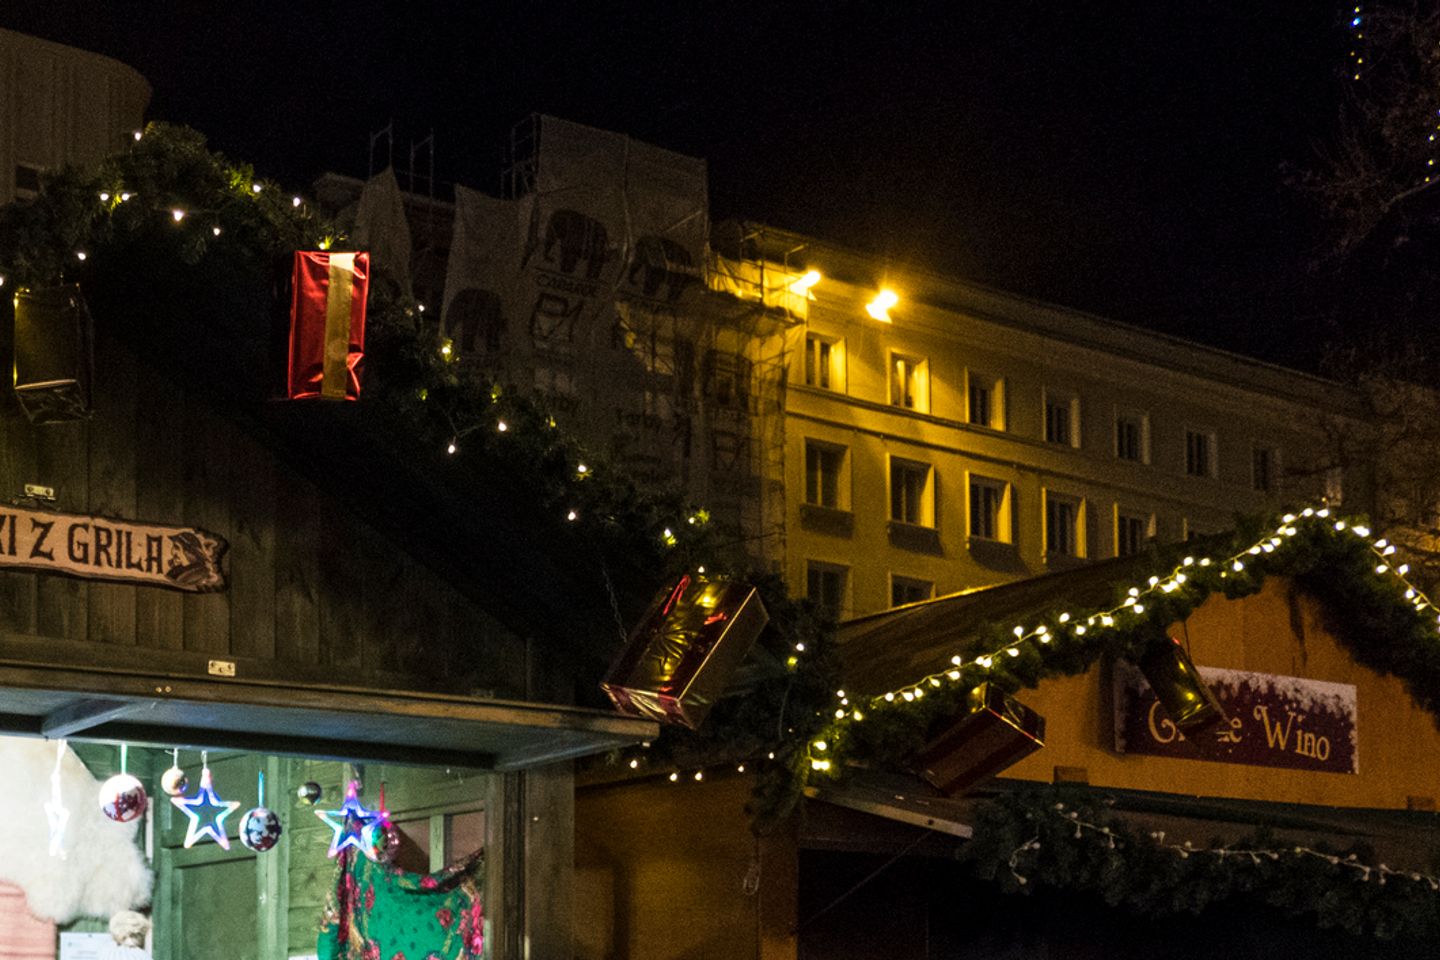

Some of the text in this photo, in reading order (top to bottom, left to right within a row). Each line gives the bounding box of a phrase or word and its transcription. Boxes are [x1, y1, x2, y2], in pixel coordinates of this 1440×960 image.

[29, 516, 56, 562] Z
[67, 522, 165, 575] GRILA
[1253, 704, 1331, 761] Wino
